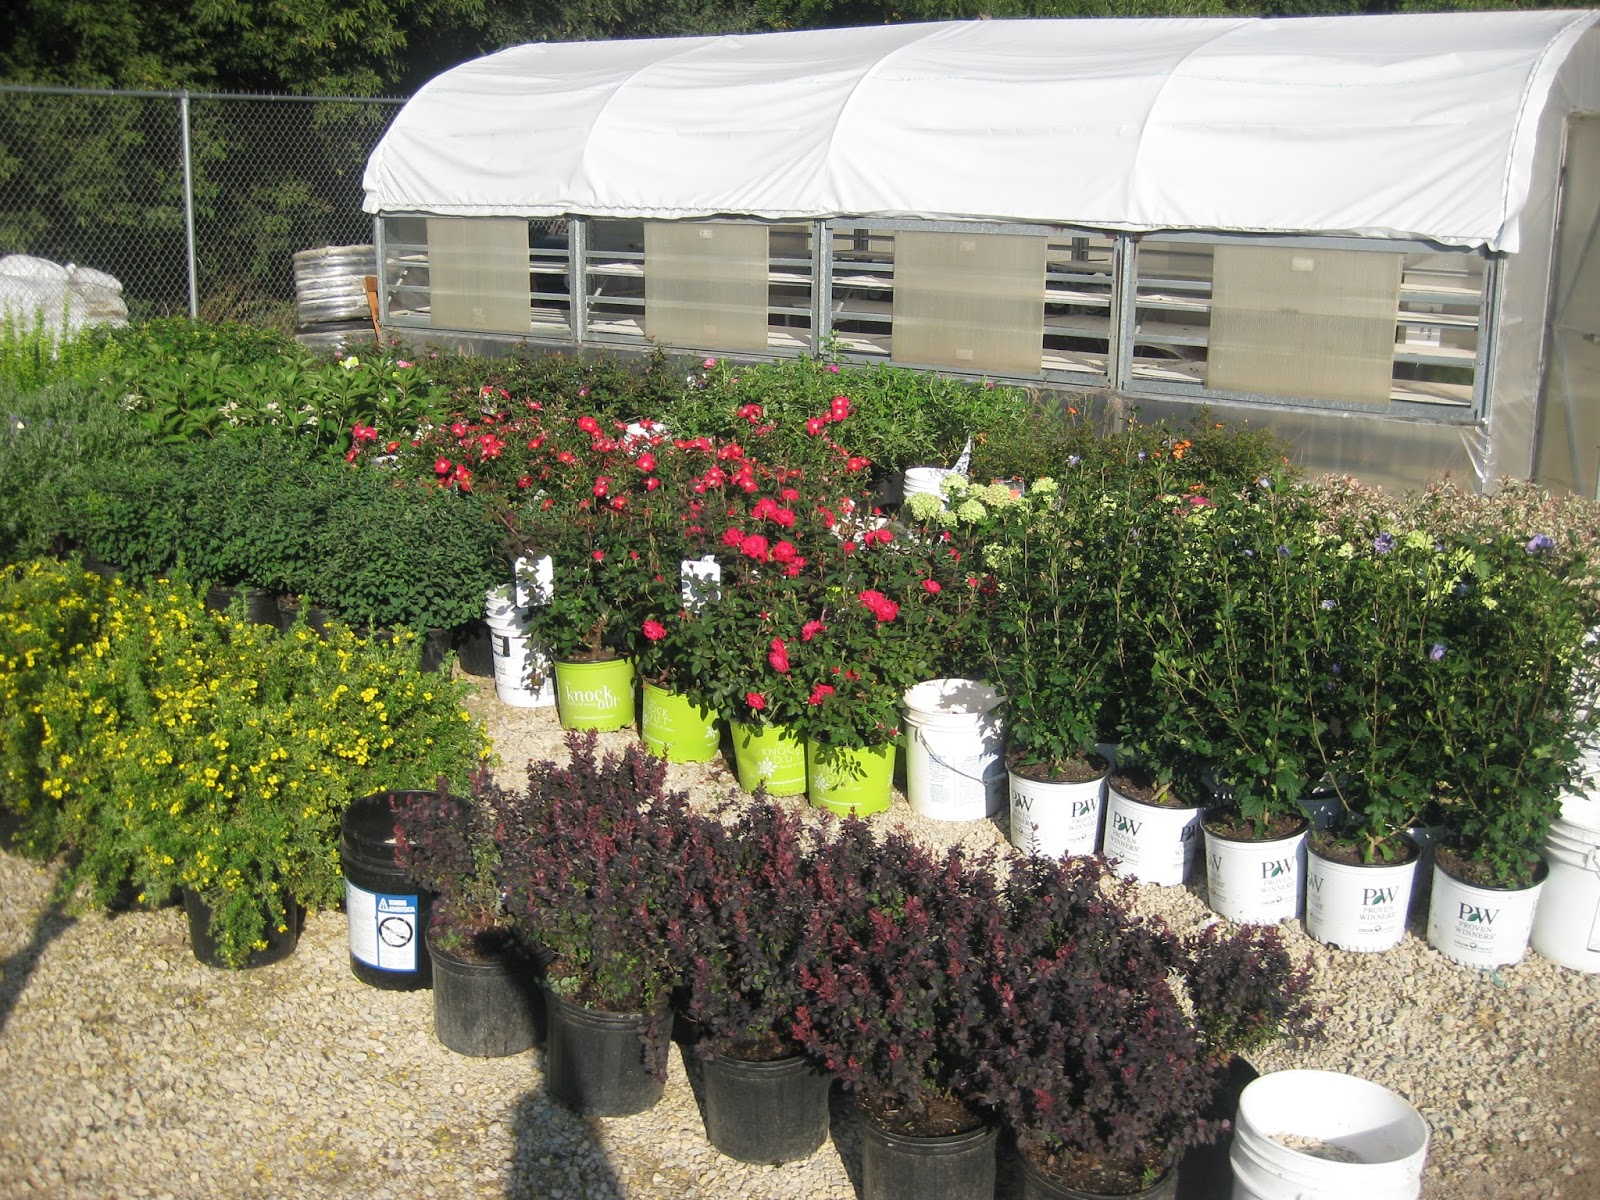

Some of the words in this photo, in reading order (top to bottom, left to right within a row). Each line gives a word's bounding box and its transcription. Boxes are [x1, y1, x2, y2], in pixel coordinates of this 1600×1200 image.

[566, 684, 613, 704] knock
[597, 696, 618, 711] out
[1112, 810, 1143, 837] PW
[1110, 834, 1140, 853] WINNERS
[1112, 829, 1137, 845] PROVEN
[1261, 855, 1295, 879] PW
[1259, 880, 1295, 894] WINNERS
[1263, 876, 1292, 887] PROVEN
[1361, 885, 1400, 906] PW
[1359, 911, 1396, 922] WINNERS
[1363, 905, 1394, 915] PROVEN
[1456, 901, 1500, 925] PW
[1455, 925, 1496, 940] WINNERS
[1458, 921, 1493, 933] PROVEN
